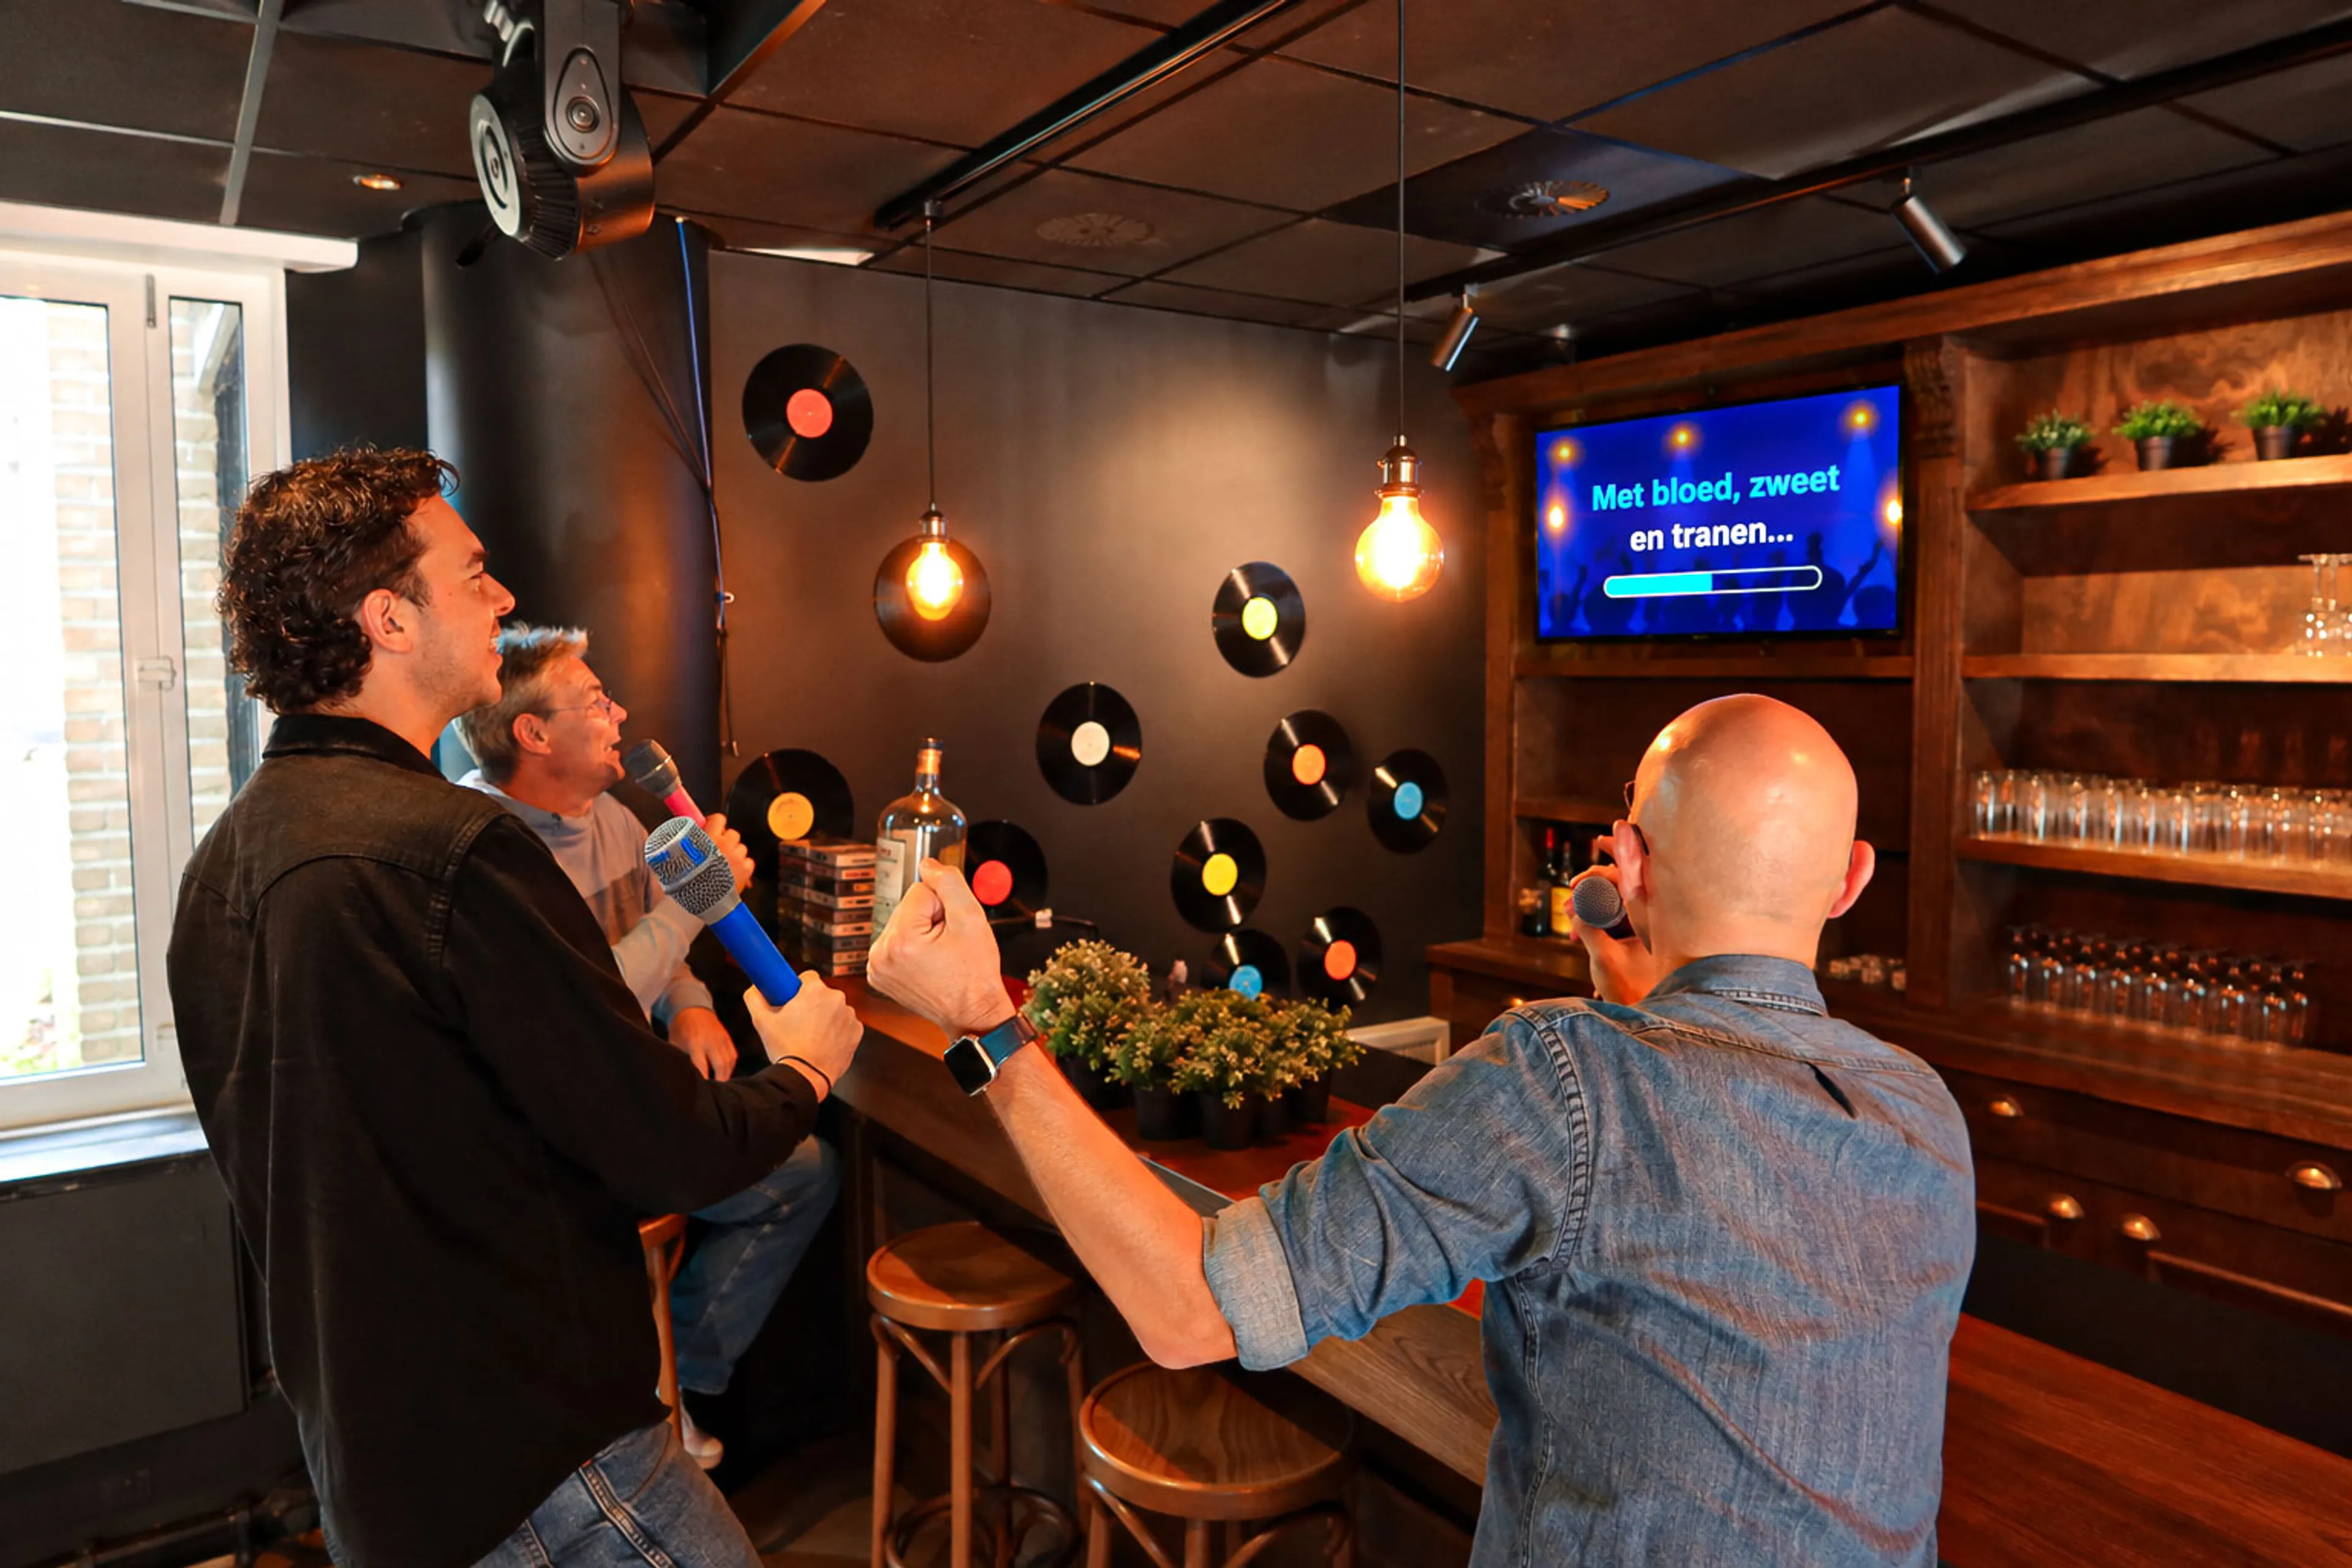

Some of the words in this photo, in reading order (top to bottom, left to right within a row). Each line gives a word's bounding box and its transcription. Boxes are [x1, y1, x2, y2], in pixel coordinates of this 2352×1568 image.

[1593, 483, 1645, 511] Met
[1653, 472, 1740, 507] bloed,
[1749, 465, 1840, 498] zweet
[1630, 529, 1664, 552] en
[1671, 521, 1794, 549] tranen...
